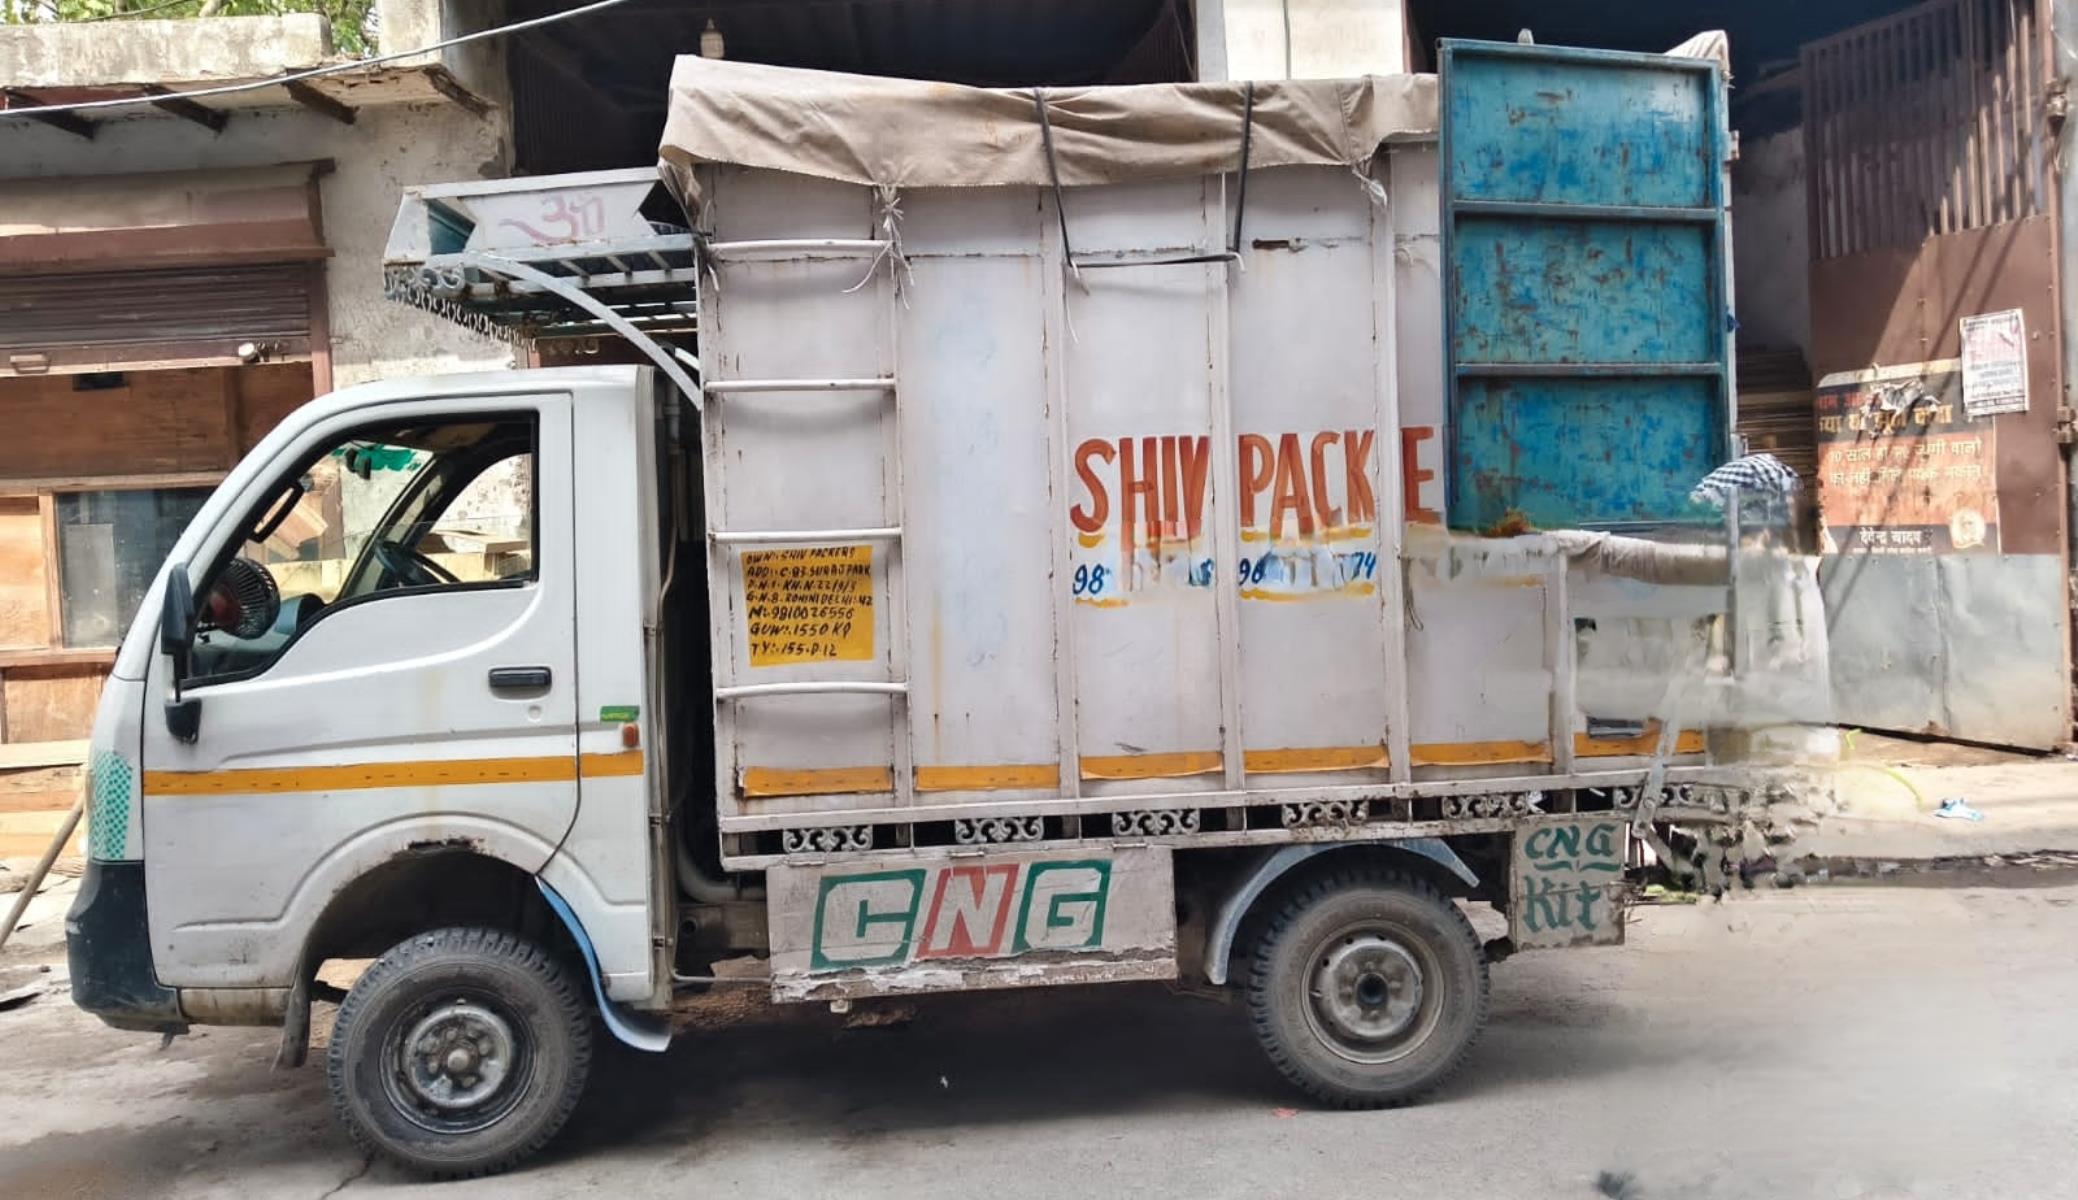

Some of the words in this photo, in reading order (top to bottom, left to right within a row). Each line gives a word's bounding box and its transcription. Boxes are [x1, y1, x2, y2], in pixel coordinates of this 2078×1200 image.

[1070, 436, 1211, 541] SHIV
[1525, 823, 1619, 860] CNG
[810, 858, 1113, 971] CNG
[1523, 875, 1601, 933] Kit
